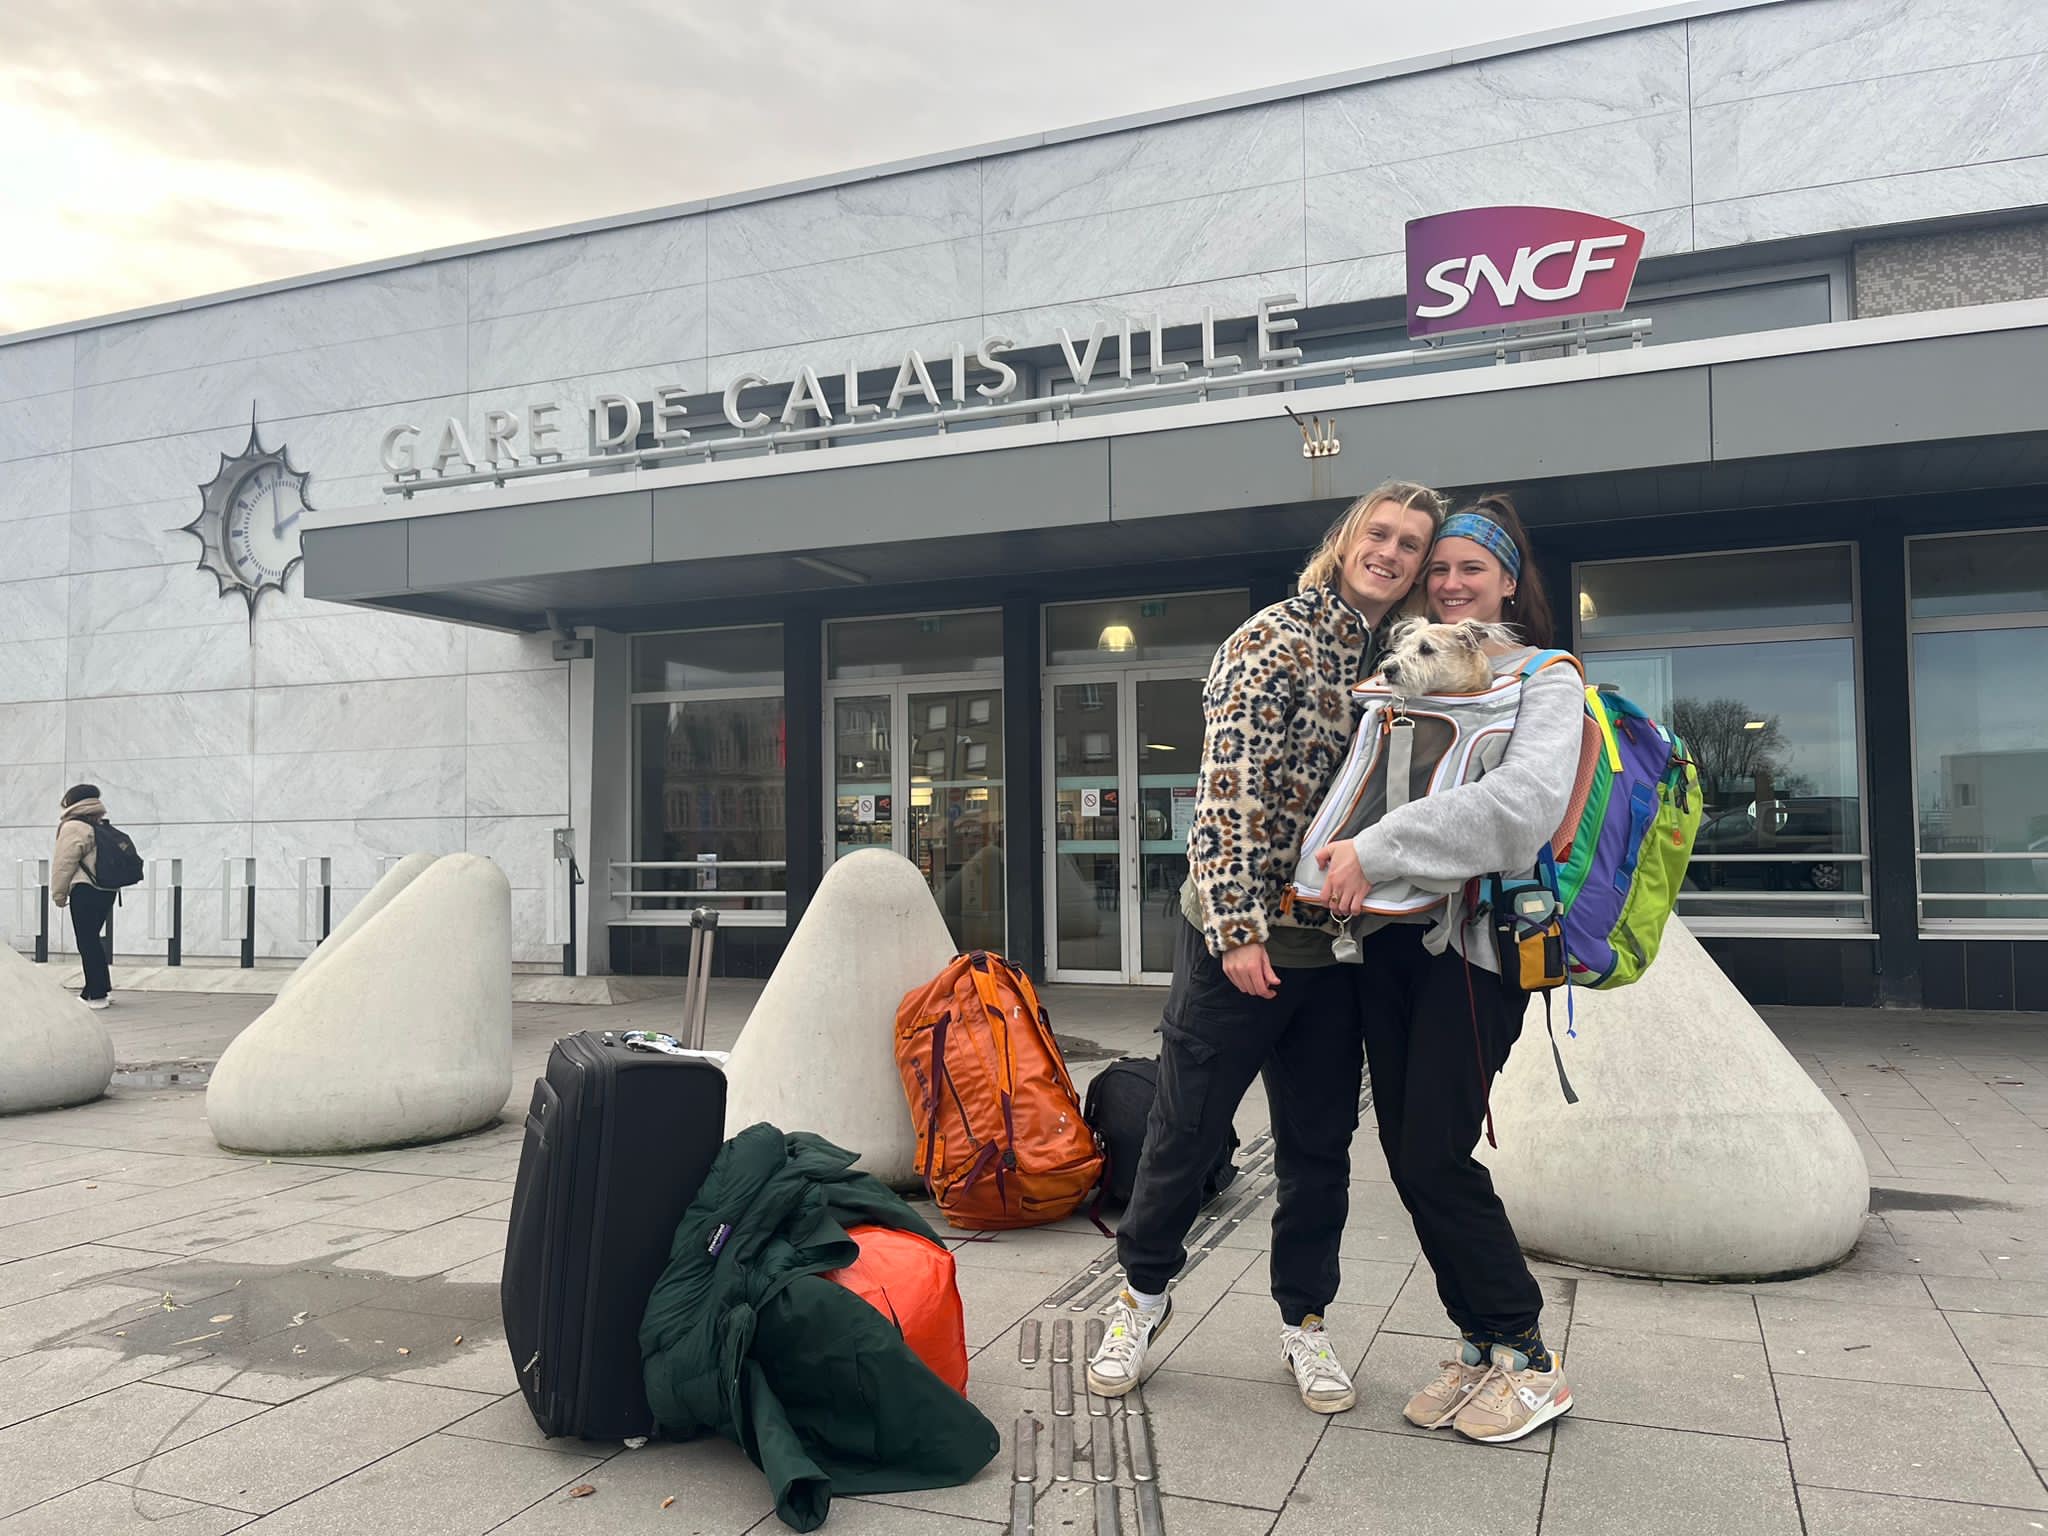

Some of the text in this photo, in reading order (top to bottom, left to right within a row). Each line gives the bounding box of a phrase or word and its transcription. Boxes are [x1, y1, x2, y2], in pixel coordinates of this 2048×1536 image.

[1415, 233, 1629, 318] SNCF
[380, 293, 1302, 476] GARE DE CALAIS VILLE
